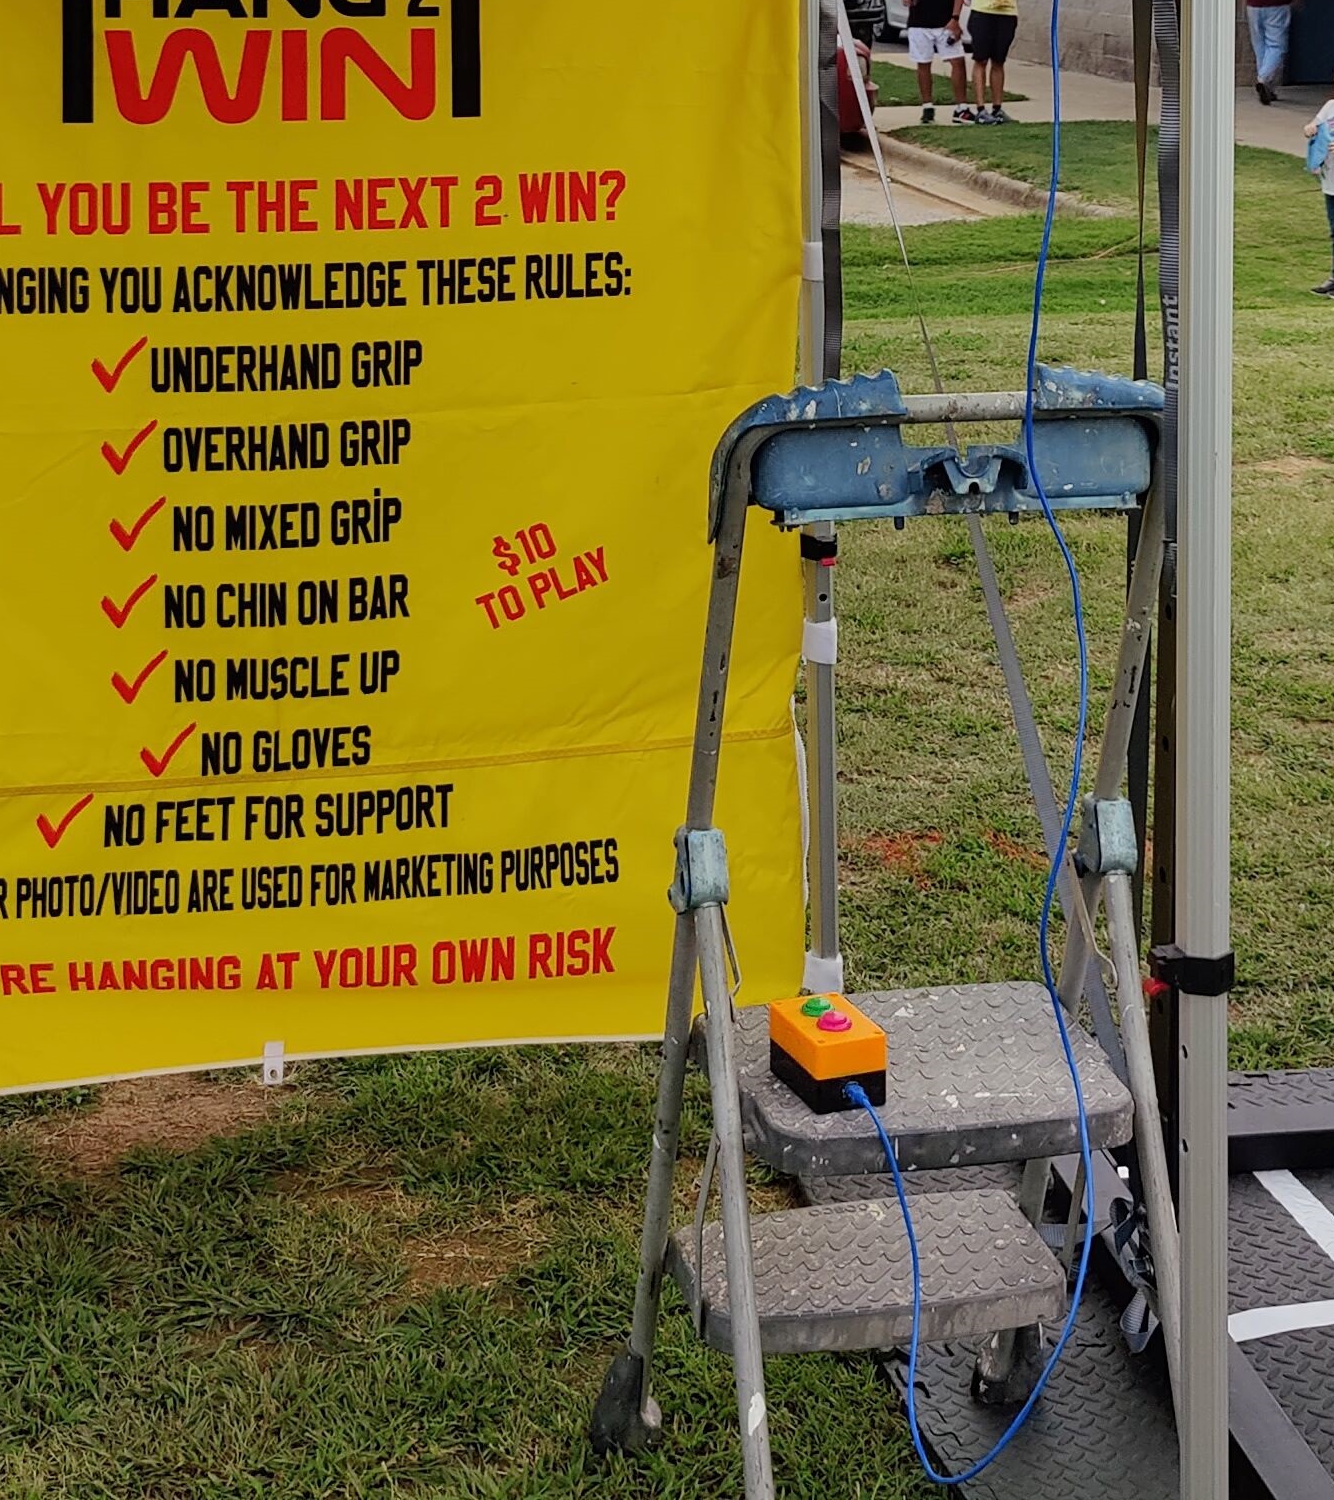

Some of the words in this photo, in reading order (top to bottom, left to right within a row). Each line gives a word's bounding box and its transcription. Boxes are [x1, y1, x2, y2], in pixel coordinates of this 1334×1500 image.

[104, 27, 436, 125] WIN
[36, 182, 131, 236] YOU
[148, 181, 210, 235] BE
[226, 179, 318, 233] THE
[335, 176, 459, 231] NEXT
[474, 175, 503, 227] 2
[518, 170, 626, 224] WIN?
[99, 266, 162, 314] YOU
[172, 260, 407, 313] ACKNOWLEDGE
[416, 255, 516, 306] THESE
[525, 251, 632, 300] RULES:
[151, 342, 341, 393] UNDERHAND
[351, 339, 423, 388] GRIP
[163, 422, 330, 473] OVERHAND
[340, 418, 411, 467] GRIP
[173, 505, 214, 552] NO
[225, 502, 320, 551] MIXED
[491, 522, 557, 577] $10
[164, 584, 206, 629] NO
[216, 582, 287, 628] CHIN
[297, 579, 338, 626] ON
[348, 574, 410, 622] BAR
[475, 585, 526, 629] TO
[527, 546, 609, 610] PLAY
[174, 659, 216, 703] NO
[226, 653, 350, 701] MUSCLE
[360, 649, 400, 695] UP
[201, 731, 242, 777] NO
[252, 725, 372, 773] GLOVES
[103, 803, 146, 848] NO
[155, 796, 236, 844] FEET
[244, 793, 306, 841] FOR
[315, 783, 454, 837] SUPPORT
[16, 869, 180, 919] PHOTO/VIDEO
[187, 868, 234, 913] ARE
[241, 865, 303, 910] USED
[310, 863, 357, 907] FOR
[363, 852, 494, 903] MARKETING
[500, 838, 619, 893] PURPOSES
[68, 955, 241, 991] HANGING
[256, 951, 300, 990] AT
[313, 943, 417, 989] YOUR
[432, 936, 515, 985] OWN
[528, 926, 616, 979] RISK
